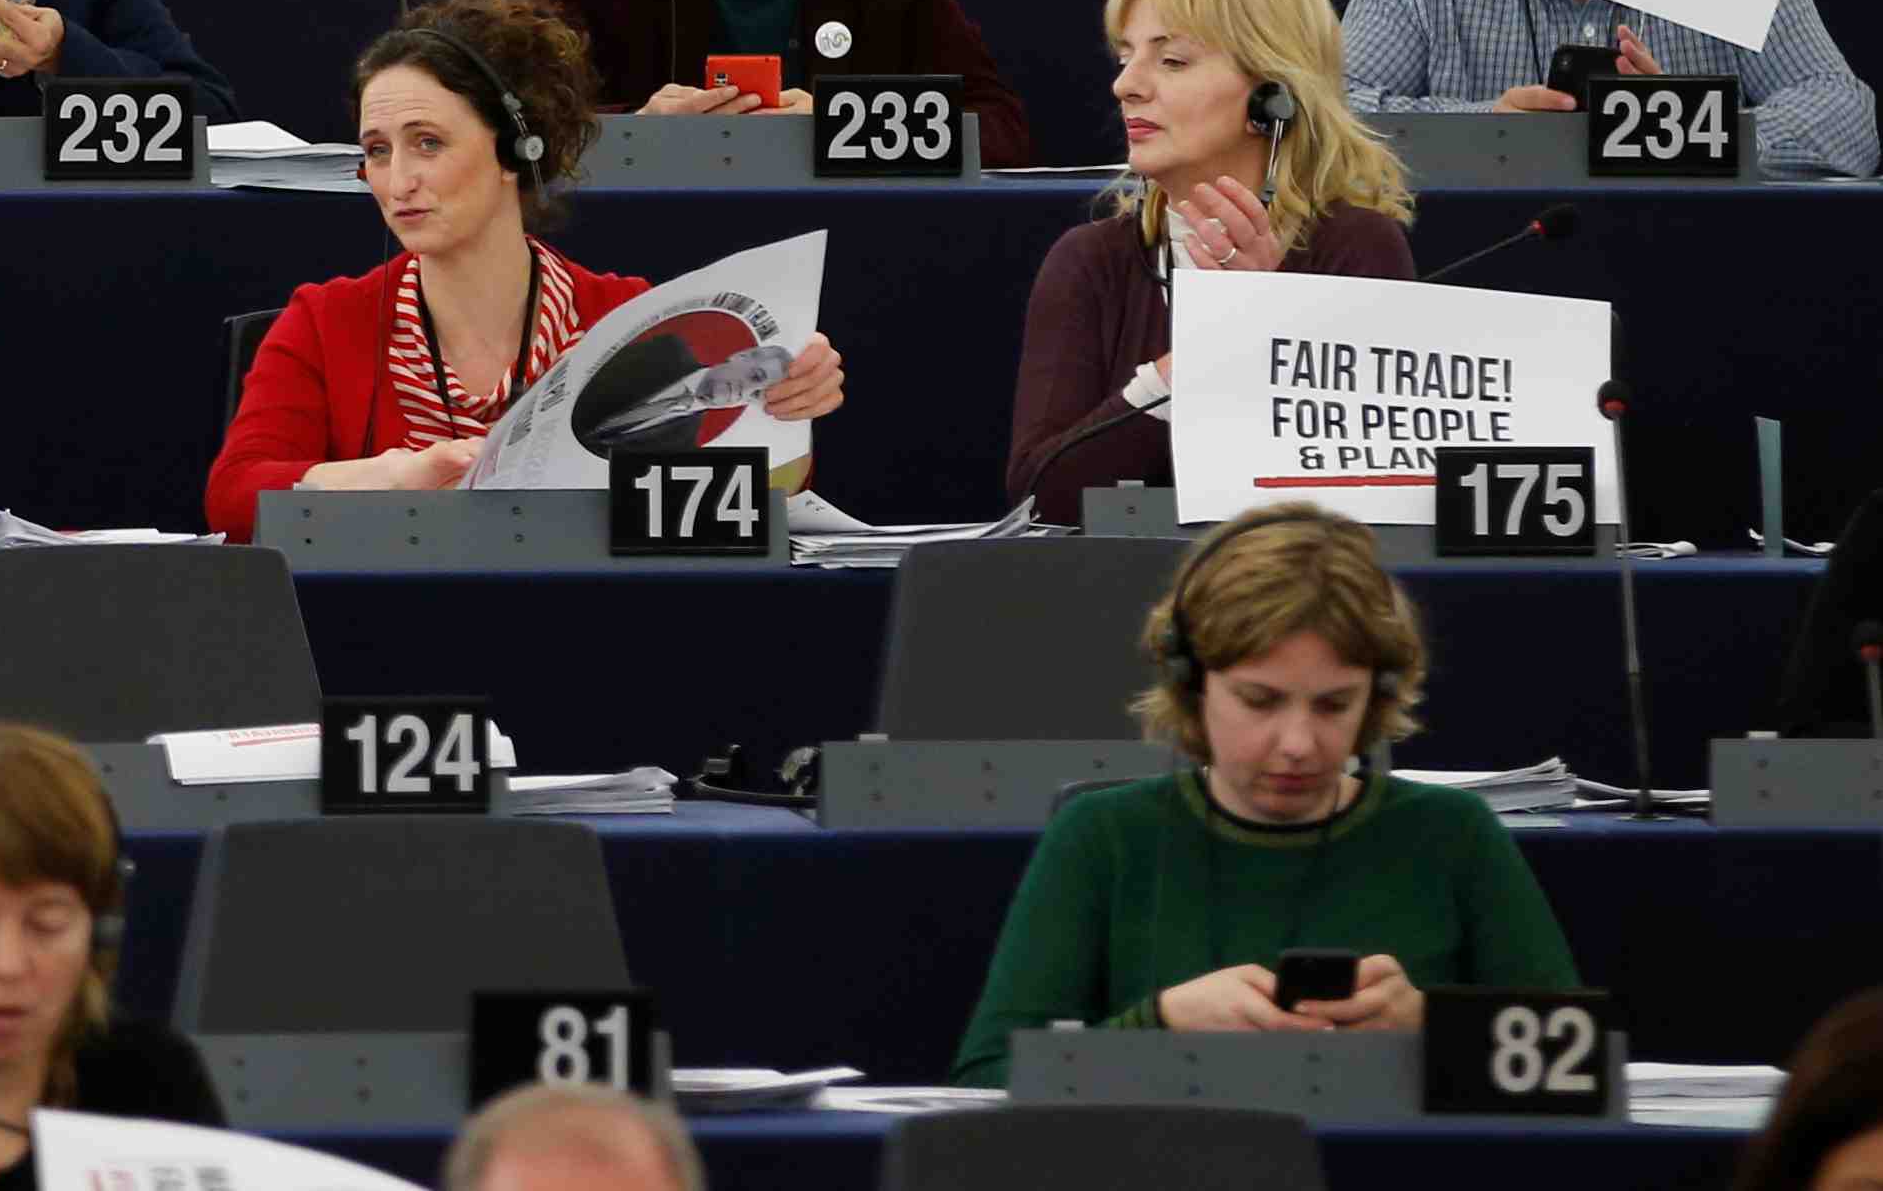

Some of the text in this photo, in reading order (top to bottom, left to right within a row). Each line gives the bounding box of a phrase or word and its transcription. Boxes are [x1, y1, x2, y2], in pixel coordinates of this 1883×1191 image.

[59, 93, 184, 164] 232
[827, 90, 952, 160] 233
[1602, 90, 1729, 160] 234
[1269, 337, 1513, 403] FAIR TRADE!
[1272, 396, 1514, 443] FOR PEOPLE
[1299, 445, 1437, 470] & PLAN
[634, 464, 760, 538] 174
[1459, 462, 1586, 538] 175
[347, 713, 481, 794] 124
[539, 1005, 629, 1088] 81
[1491, 1006, 1597, 1094] 82
